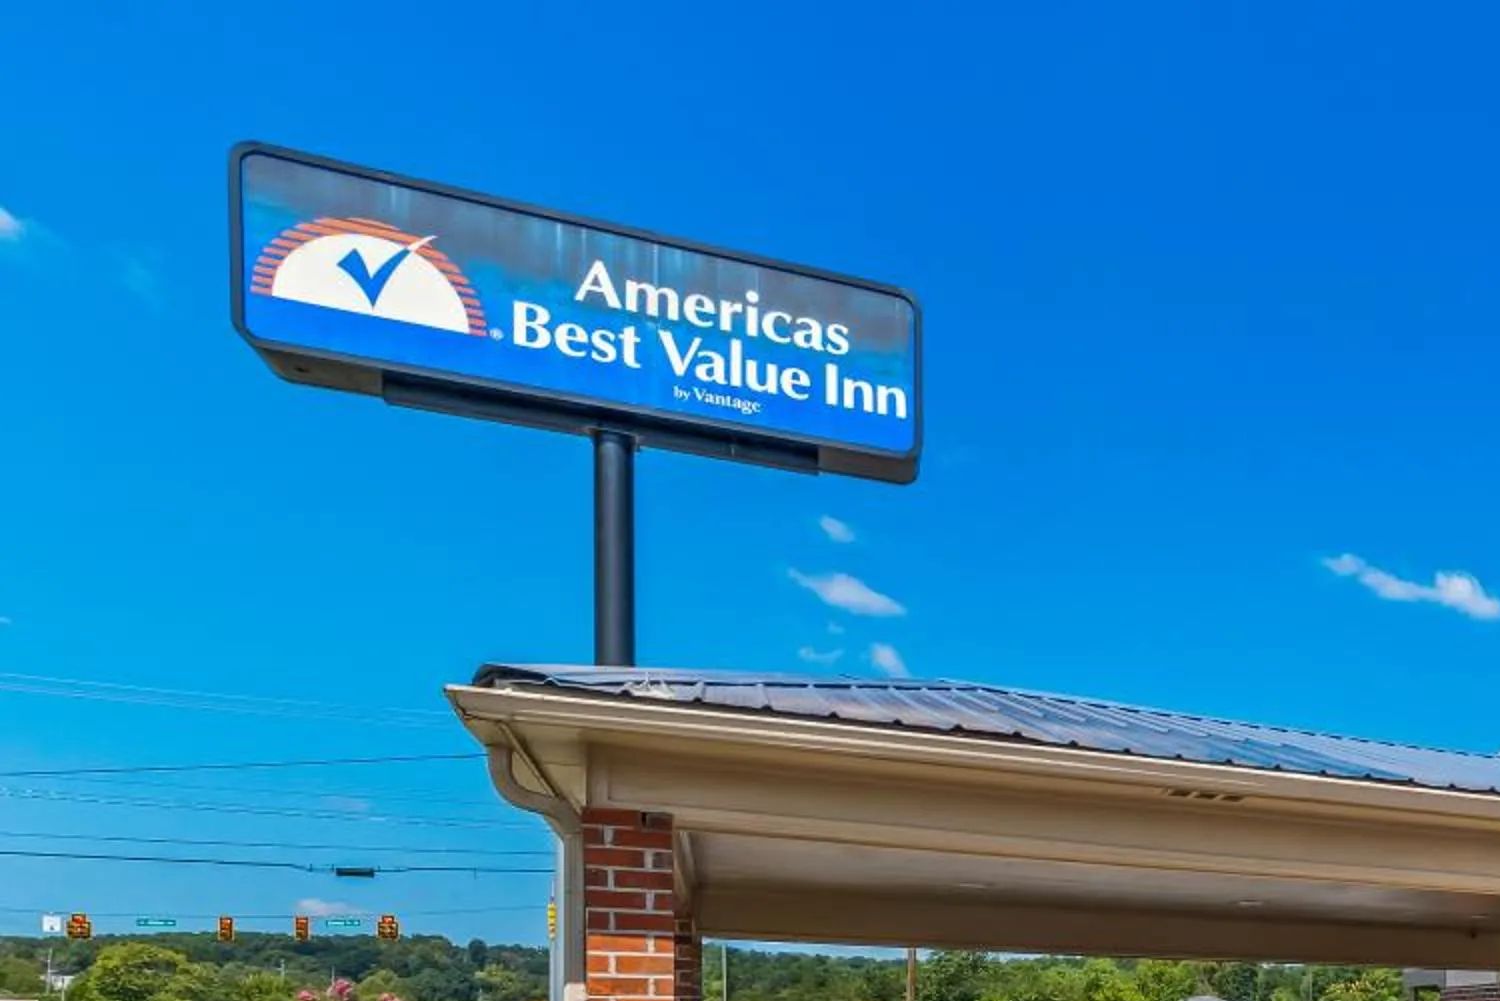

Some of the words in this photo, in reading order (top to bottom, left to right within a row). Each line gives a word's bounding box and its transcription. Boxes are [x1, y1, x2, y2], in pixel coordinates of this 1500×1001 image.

[574, 259, 850, 356] Americas
[512, 299, 642, 369] Best
[657, 328, 812, 401] Value
[825, 362, 908, 420] Inn
[672, 384, 691, 401] by
[691, 385, 762, 416] Vantage
